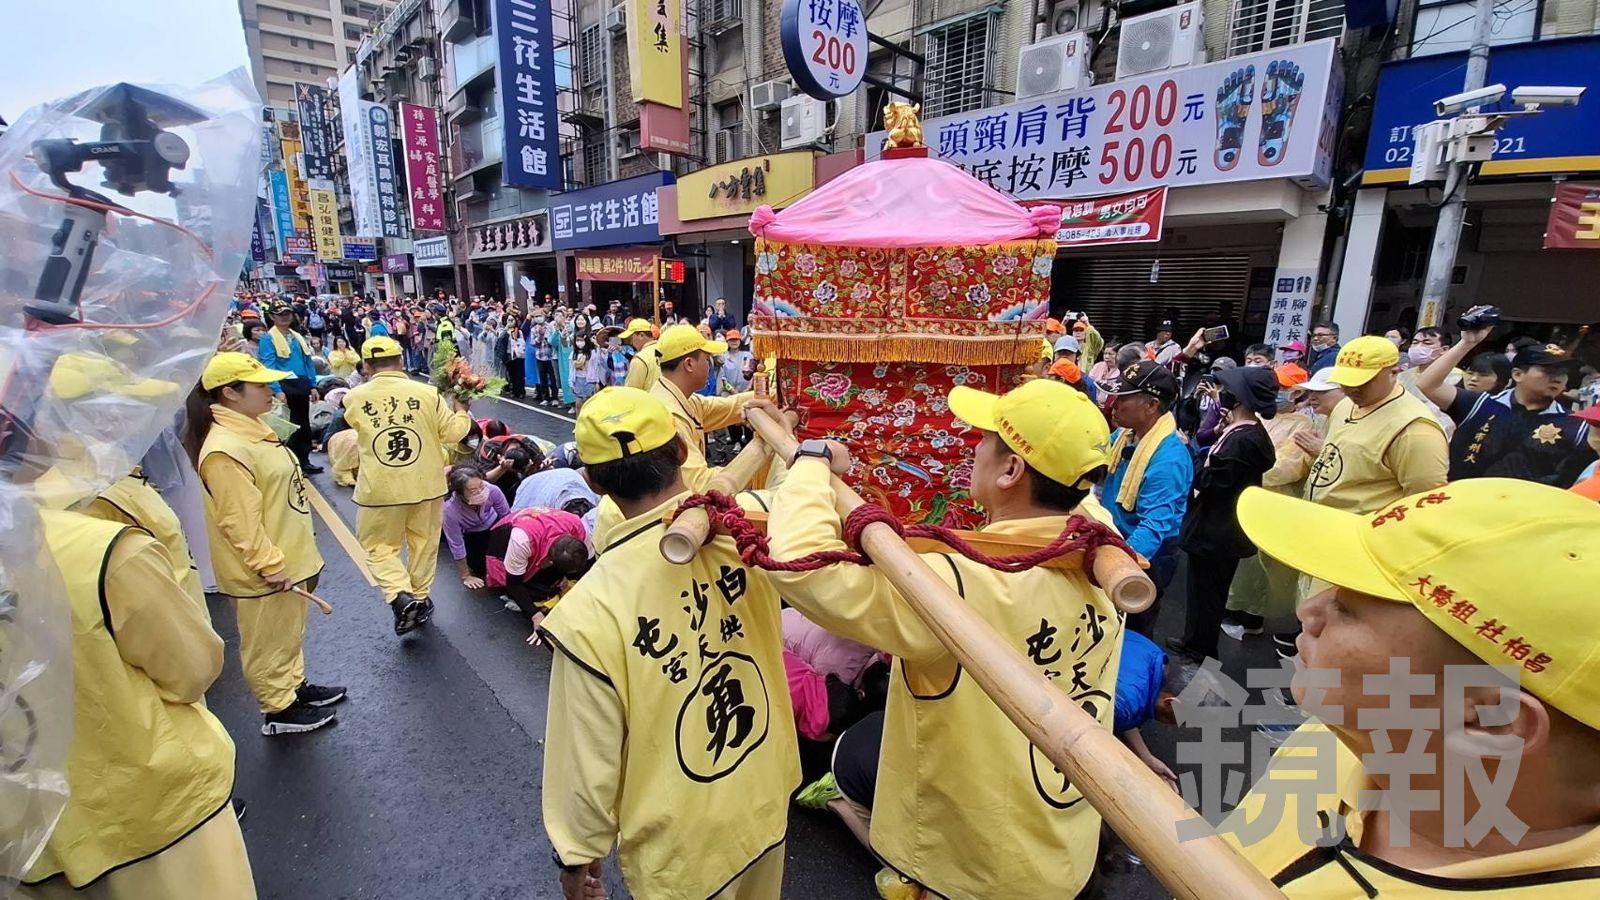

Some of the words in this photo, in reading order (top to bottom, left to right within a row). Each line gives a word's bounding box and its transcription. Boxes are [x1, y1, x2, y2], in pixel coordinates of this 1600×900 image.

[808, 0, 859, 38] 按摩
[812, 30, 855, 75] 200
[510, 0, 548, 175] 三花生活館
[829, 72, 840, 89] 元
[938, 97, 1096, 158] 頭頸肩背
[1104, 79, 1178, 136] 200
[1184, 93, 1204, 121] 元
[709, 166, 765, 199] 八方雲集
[955, 146, 1091, 194] 底按摩
[1099, 133, 1172, 185] 500
[1176, 149, 1197, 176] 元
[575, 191, 658, 233] 三花生活館
[386, 430, 413, 461] 勇
[703, 664, 755, 767] 勇
